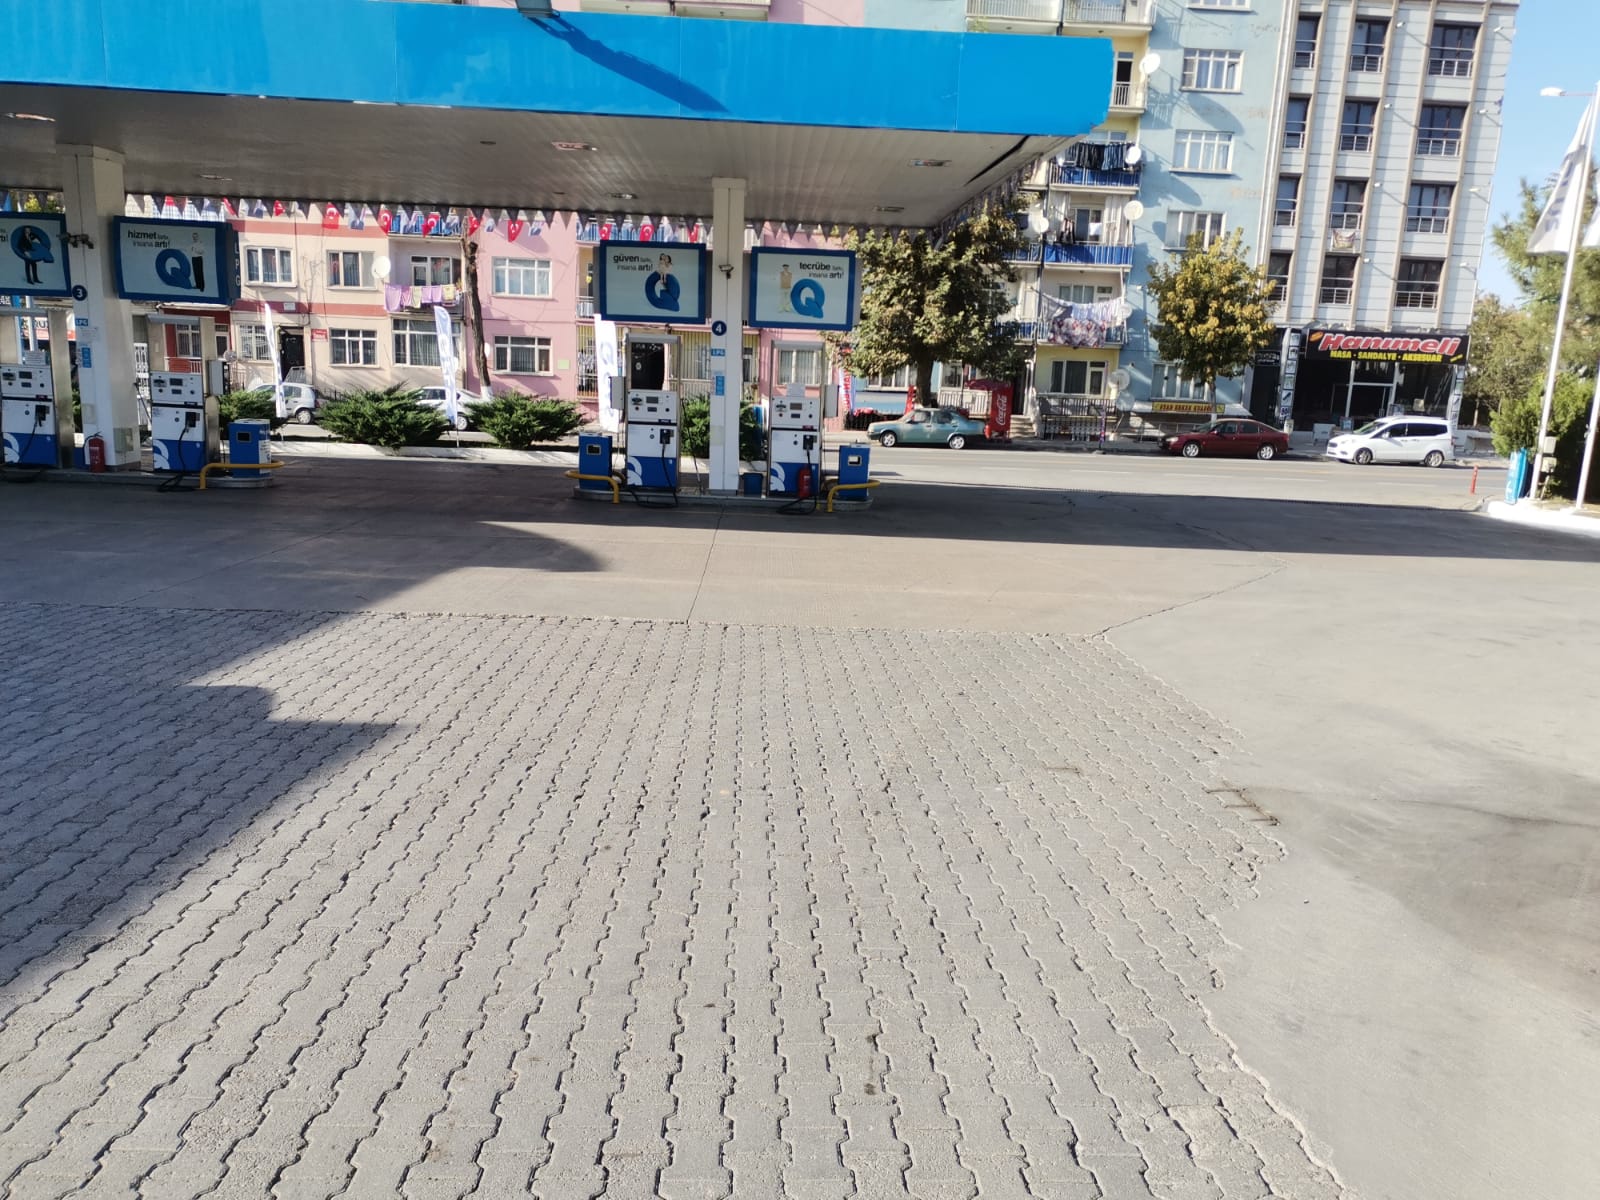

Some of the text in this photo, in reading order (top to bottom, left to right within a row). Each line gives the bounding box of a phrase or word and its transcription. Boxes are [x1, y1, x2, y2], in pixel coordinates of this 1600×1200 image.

[128, 229, 156, 239] hizmet
[613, 253, 639, 263] güven
[799, 261, 830, 271] tecrübe
[76, 288, 83, 298] 3
[715, 323, 722, 333] 4
[1330, 349, 1352, 359] MASA
[1357, 351, 1397, 361] SANDALYE
